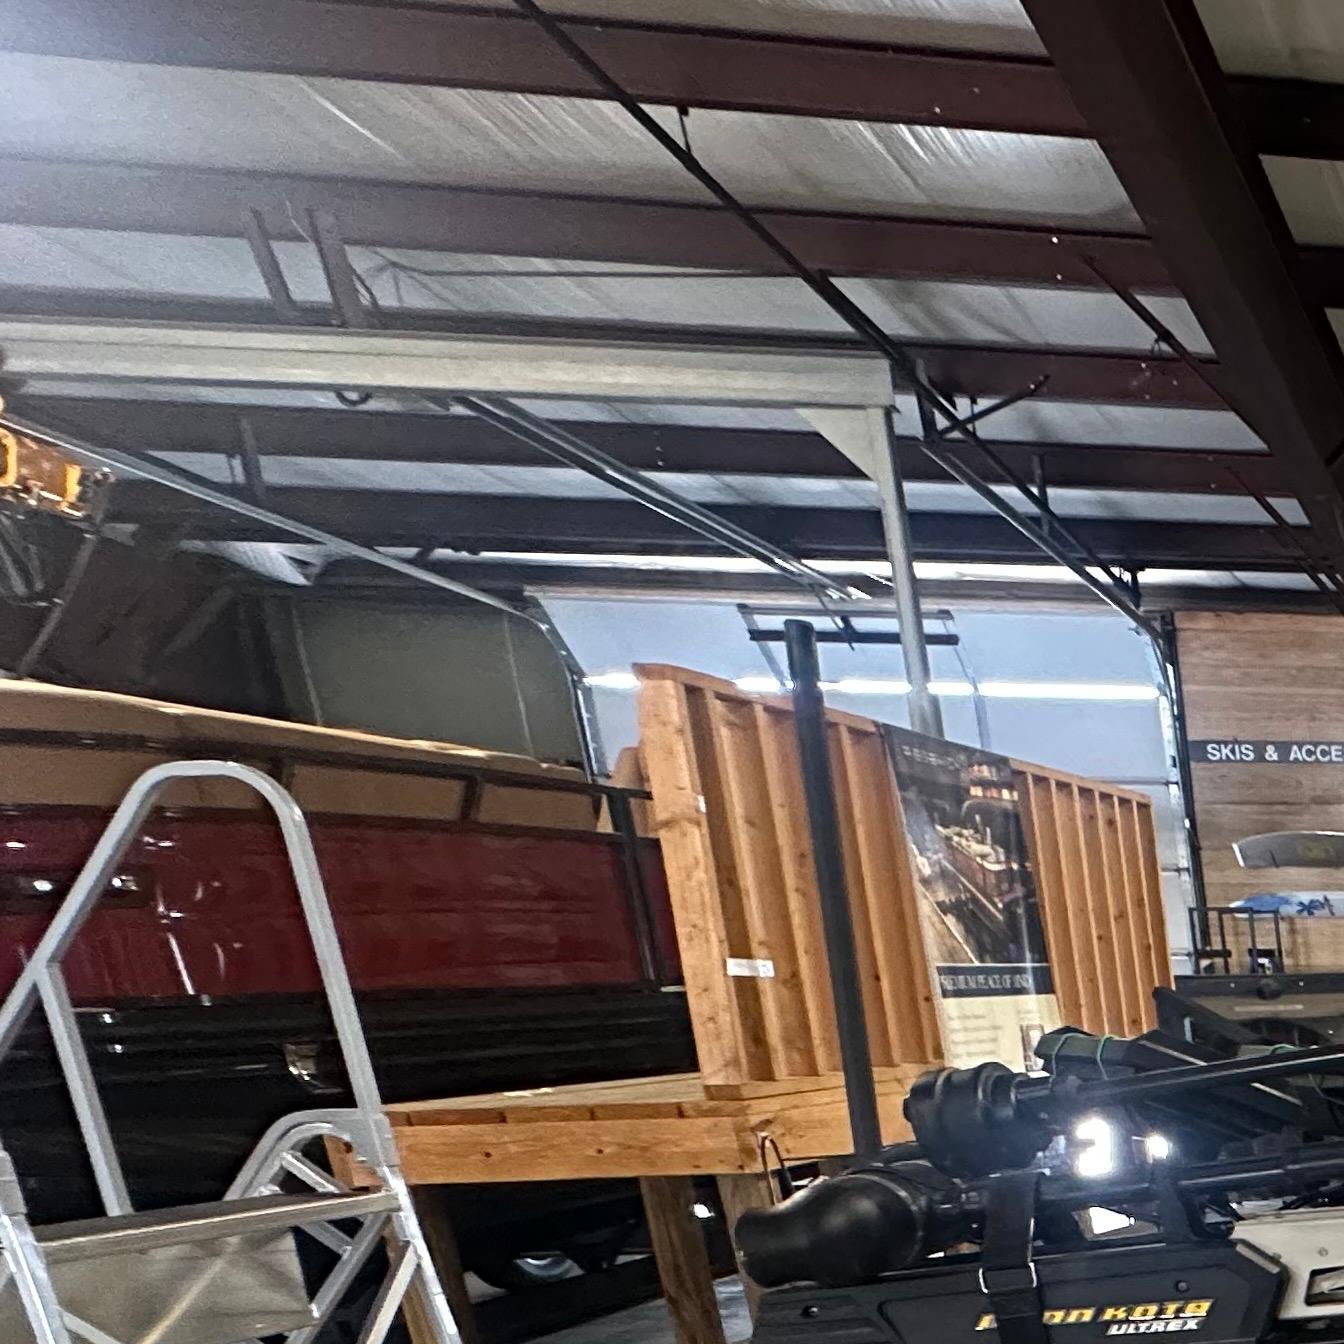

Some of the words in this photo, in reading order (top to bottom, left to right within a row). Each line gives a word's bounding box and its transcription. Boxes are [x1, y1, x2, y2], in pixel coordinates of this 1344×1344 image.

[1206, 743, 1255, 762] SKIS
[1264, 745, 1278, 762] &
[1106, 1319, 1202, 1336] ULTREX
